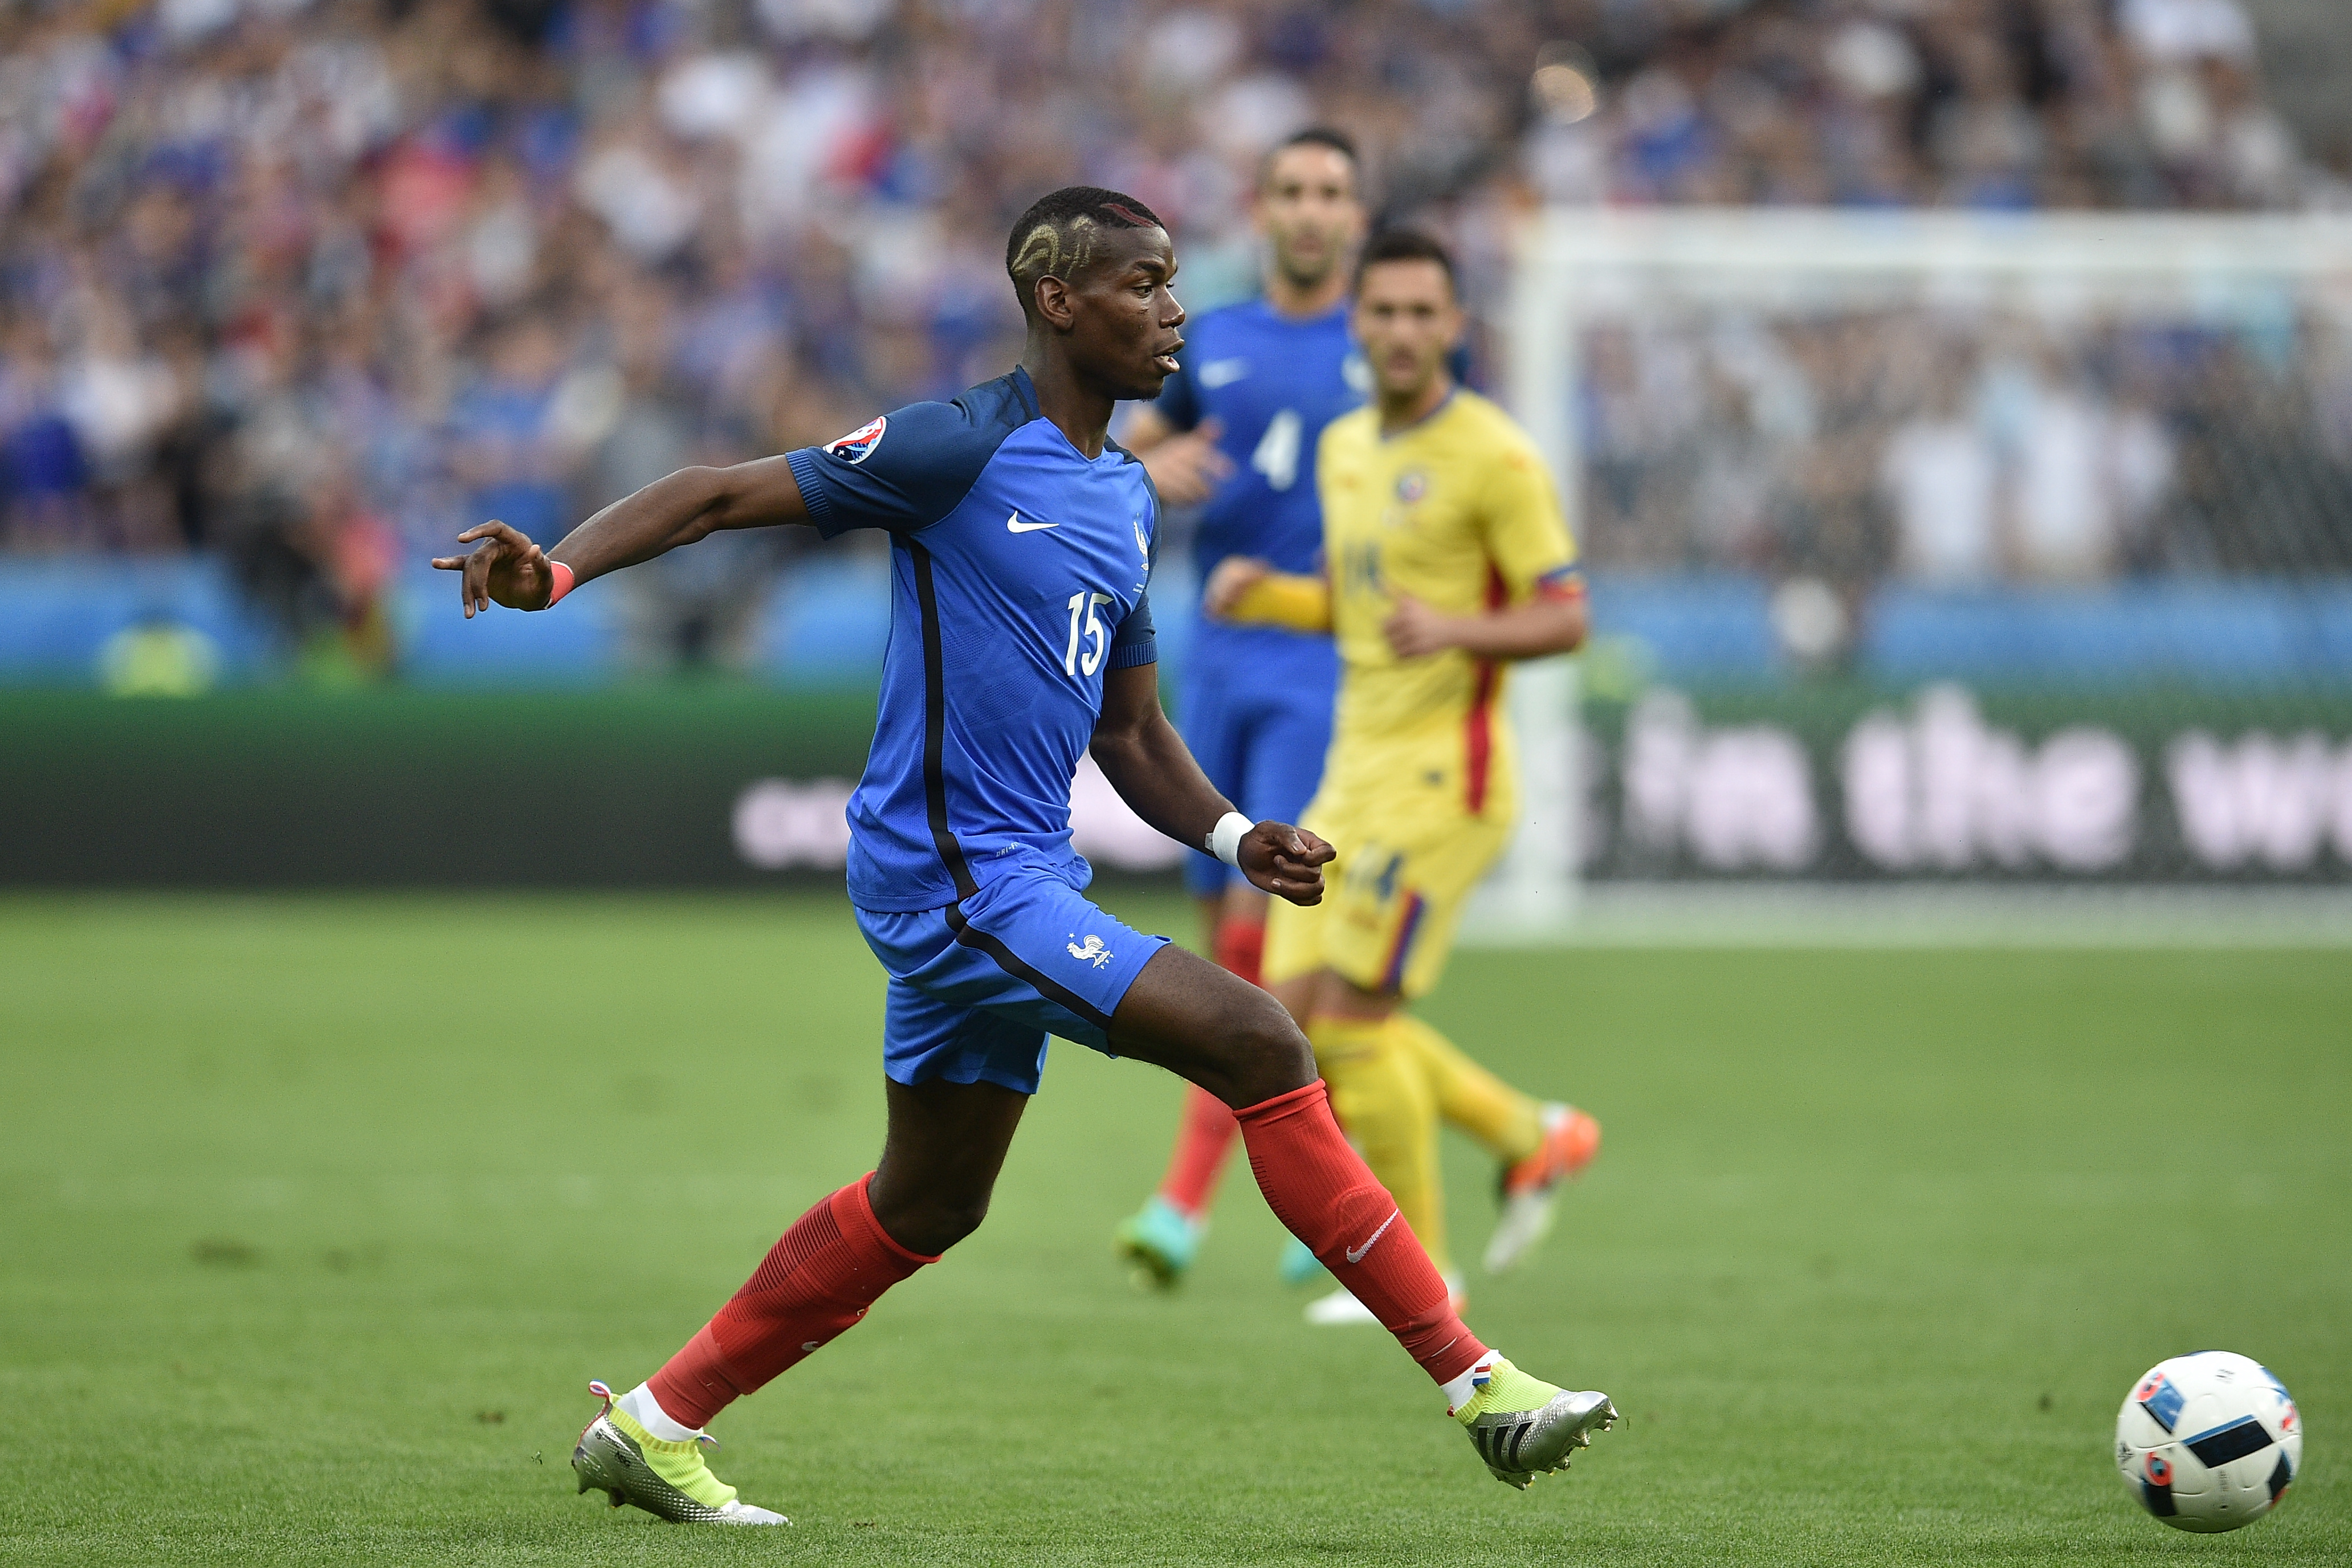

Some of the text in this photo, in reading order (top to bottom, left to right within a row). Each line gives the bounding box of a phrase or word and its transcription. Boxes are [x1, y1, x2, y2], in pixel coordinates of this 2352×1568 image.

[1252, 407, 1303, 491] 4
[1065, 591, 1114, 676] 15
[1840, 682, 2136, 872] the
[2170, 729, 2352, 872] w
[996, 842, 1021, 858] DRI-F
